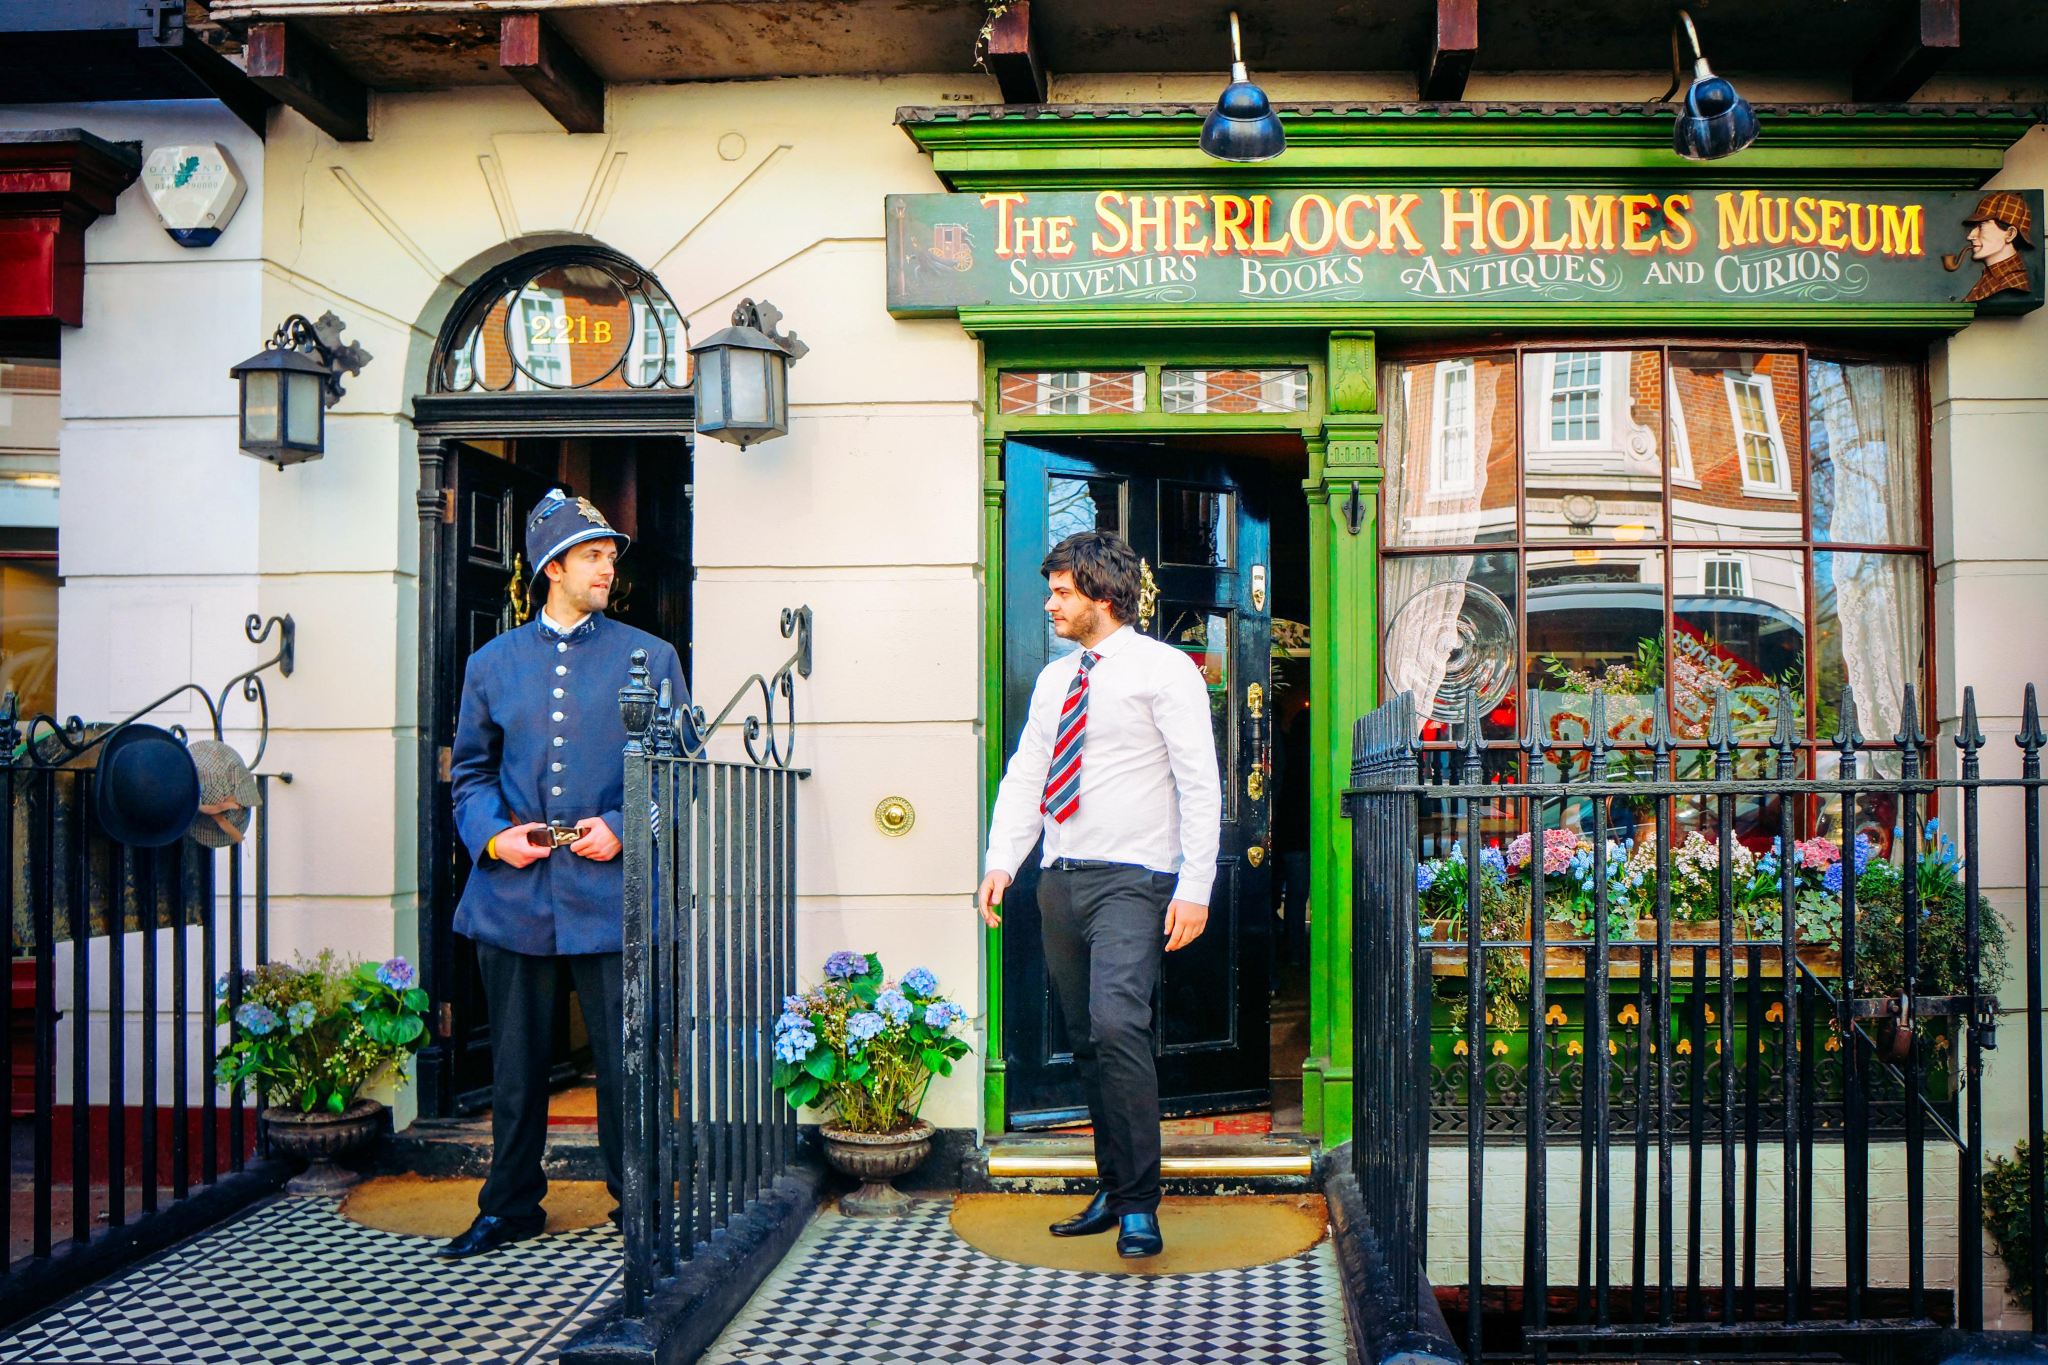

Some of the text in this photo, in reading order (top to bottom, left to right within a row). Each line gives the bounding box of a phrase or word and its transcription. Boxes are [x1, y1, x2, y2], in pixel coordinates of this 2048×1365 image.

[981, 187, 1924, 257] THE SHERLOCK HOLMES MUSEUM
[1009, 251, 1842, 297] SOUVENIRS BOOKS ANTIQUES AND CURIOS
[530, 315, 613, 345] 221B
